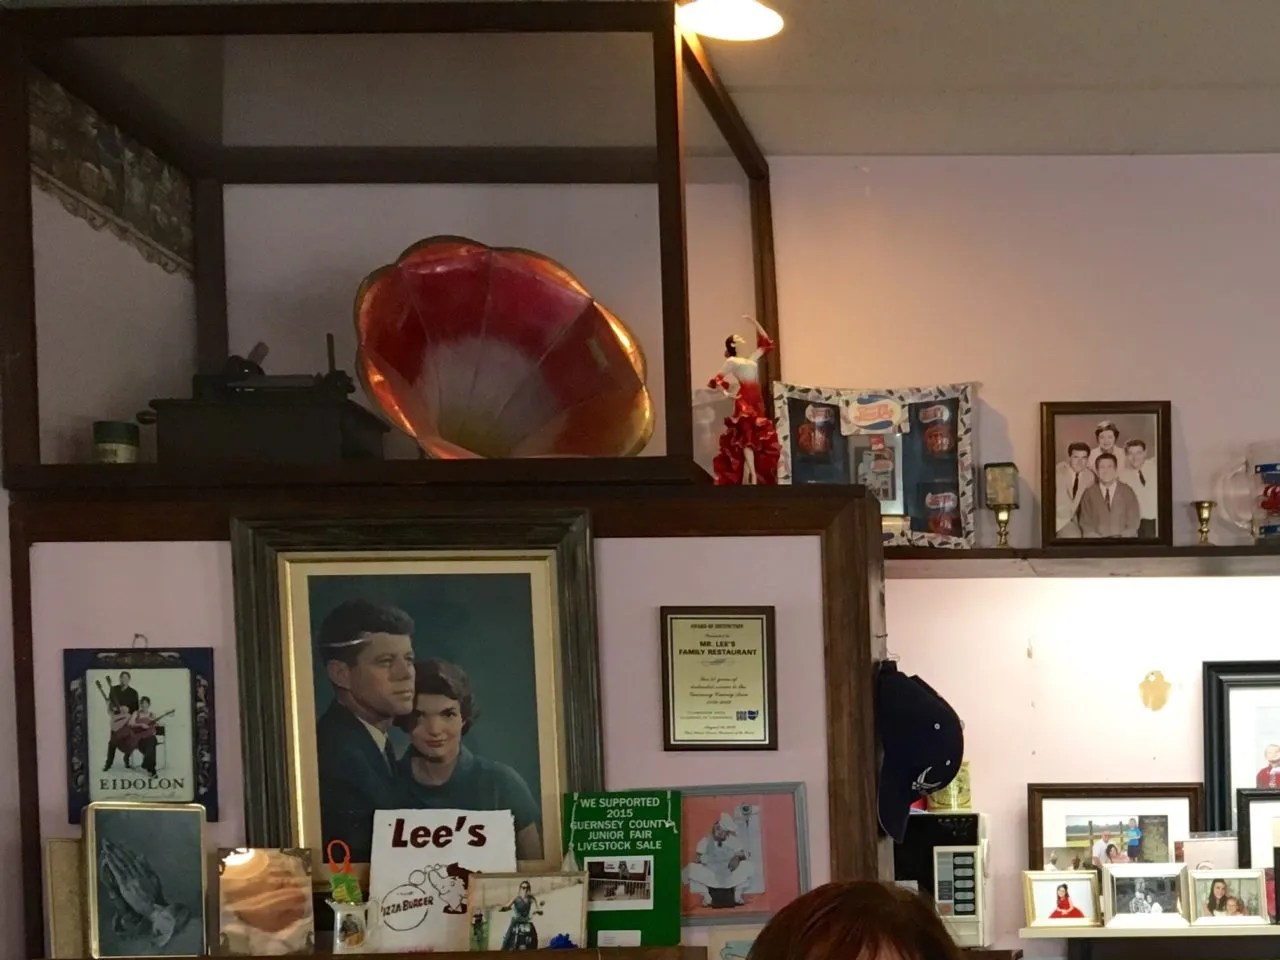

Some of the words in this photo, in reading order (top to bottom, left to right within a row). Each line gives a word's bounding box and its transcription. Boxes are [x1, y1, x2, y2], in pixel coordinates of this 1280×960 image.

[100, 778, 184, 790] EIDOLON
[580, 799, 596, 808] WE
[599, 797, 660, 807] SUPPORTED
[606, 808, 633, 818] 2015
[571, 820, 624, 830] GUERNSEY
[629, 819, 671, 829] COUNTY
[391, 816, 487, 848] Lee's
[588, 831, 624, 840] JUNIOR
[630, 830, 652, 839] FAIR
[578, 841, 631, 851] LIVESTOCK
[636, 840, 662, 850] SALE
[380, 903, 402, 917] IZZA
[402, 896, 434, 911] BURGER
